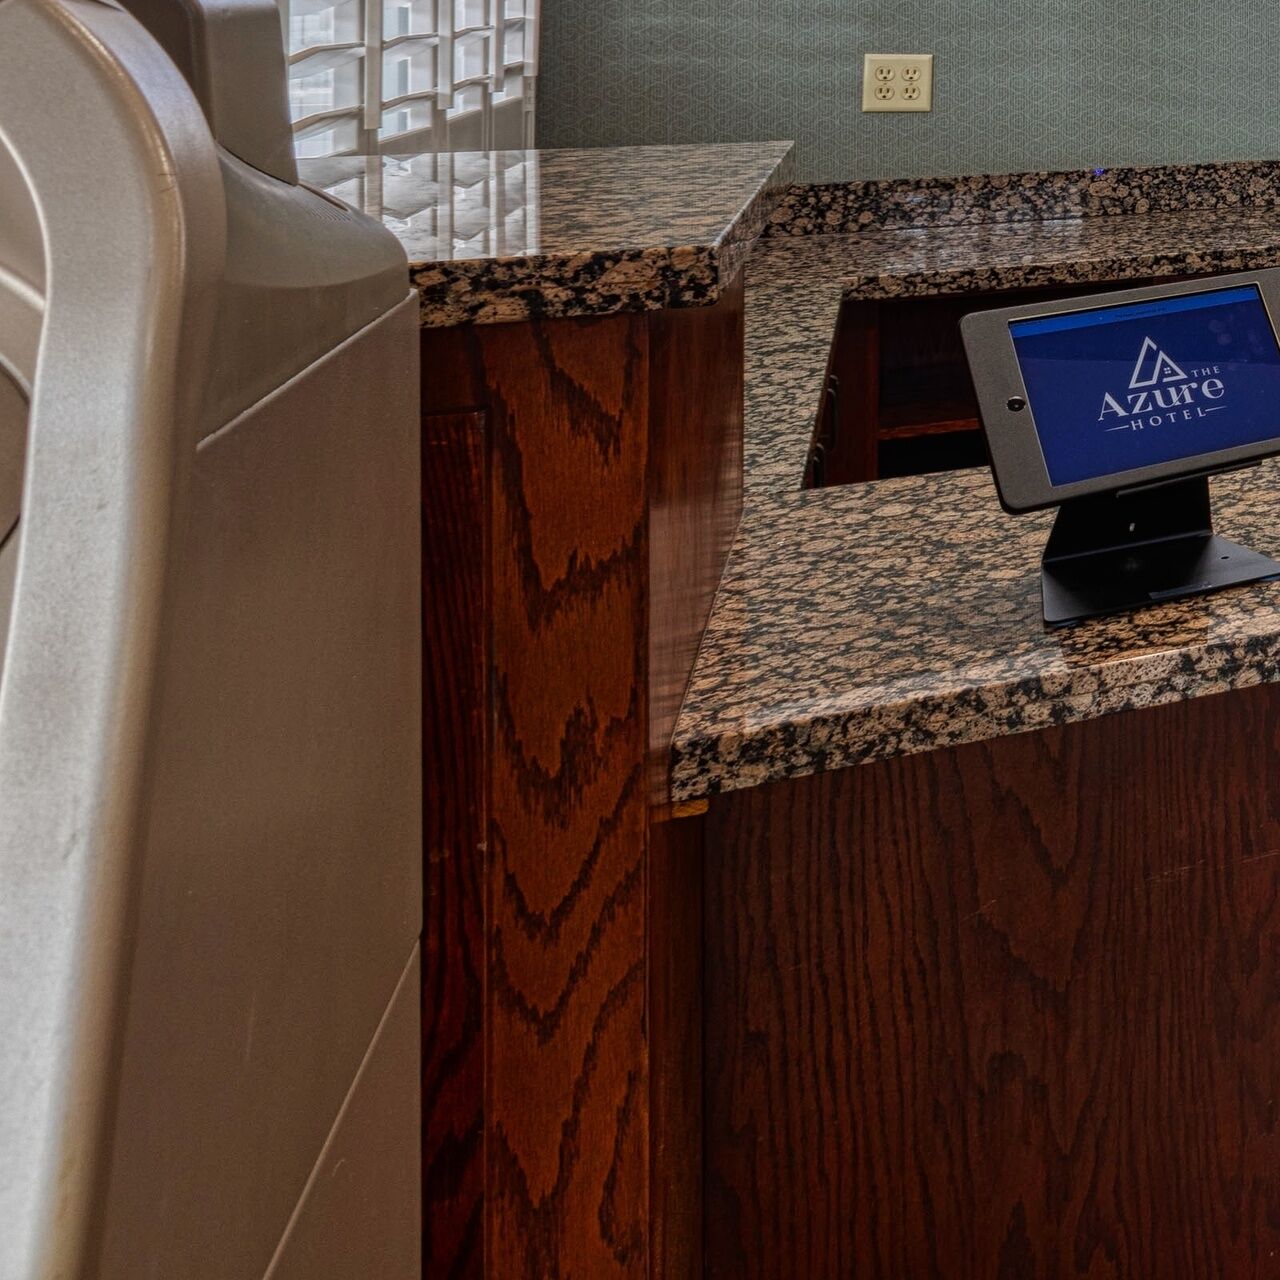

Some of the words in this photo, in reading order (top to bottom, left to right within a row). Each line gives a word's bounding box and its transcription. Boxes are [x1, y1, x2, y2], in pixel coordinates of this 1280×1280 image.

[1191, 365, 1221, 378] THE
[1098, 378, 1225, 421] Azure
[1131, 407, 1207, 431] HOTEL
